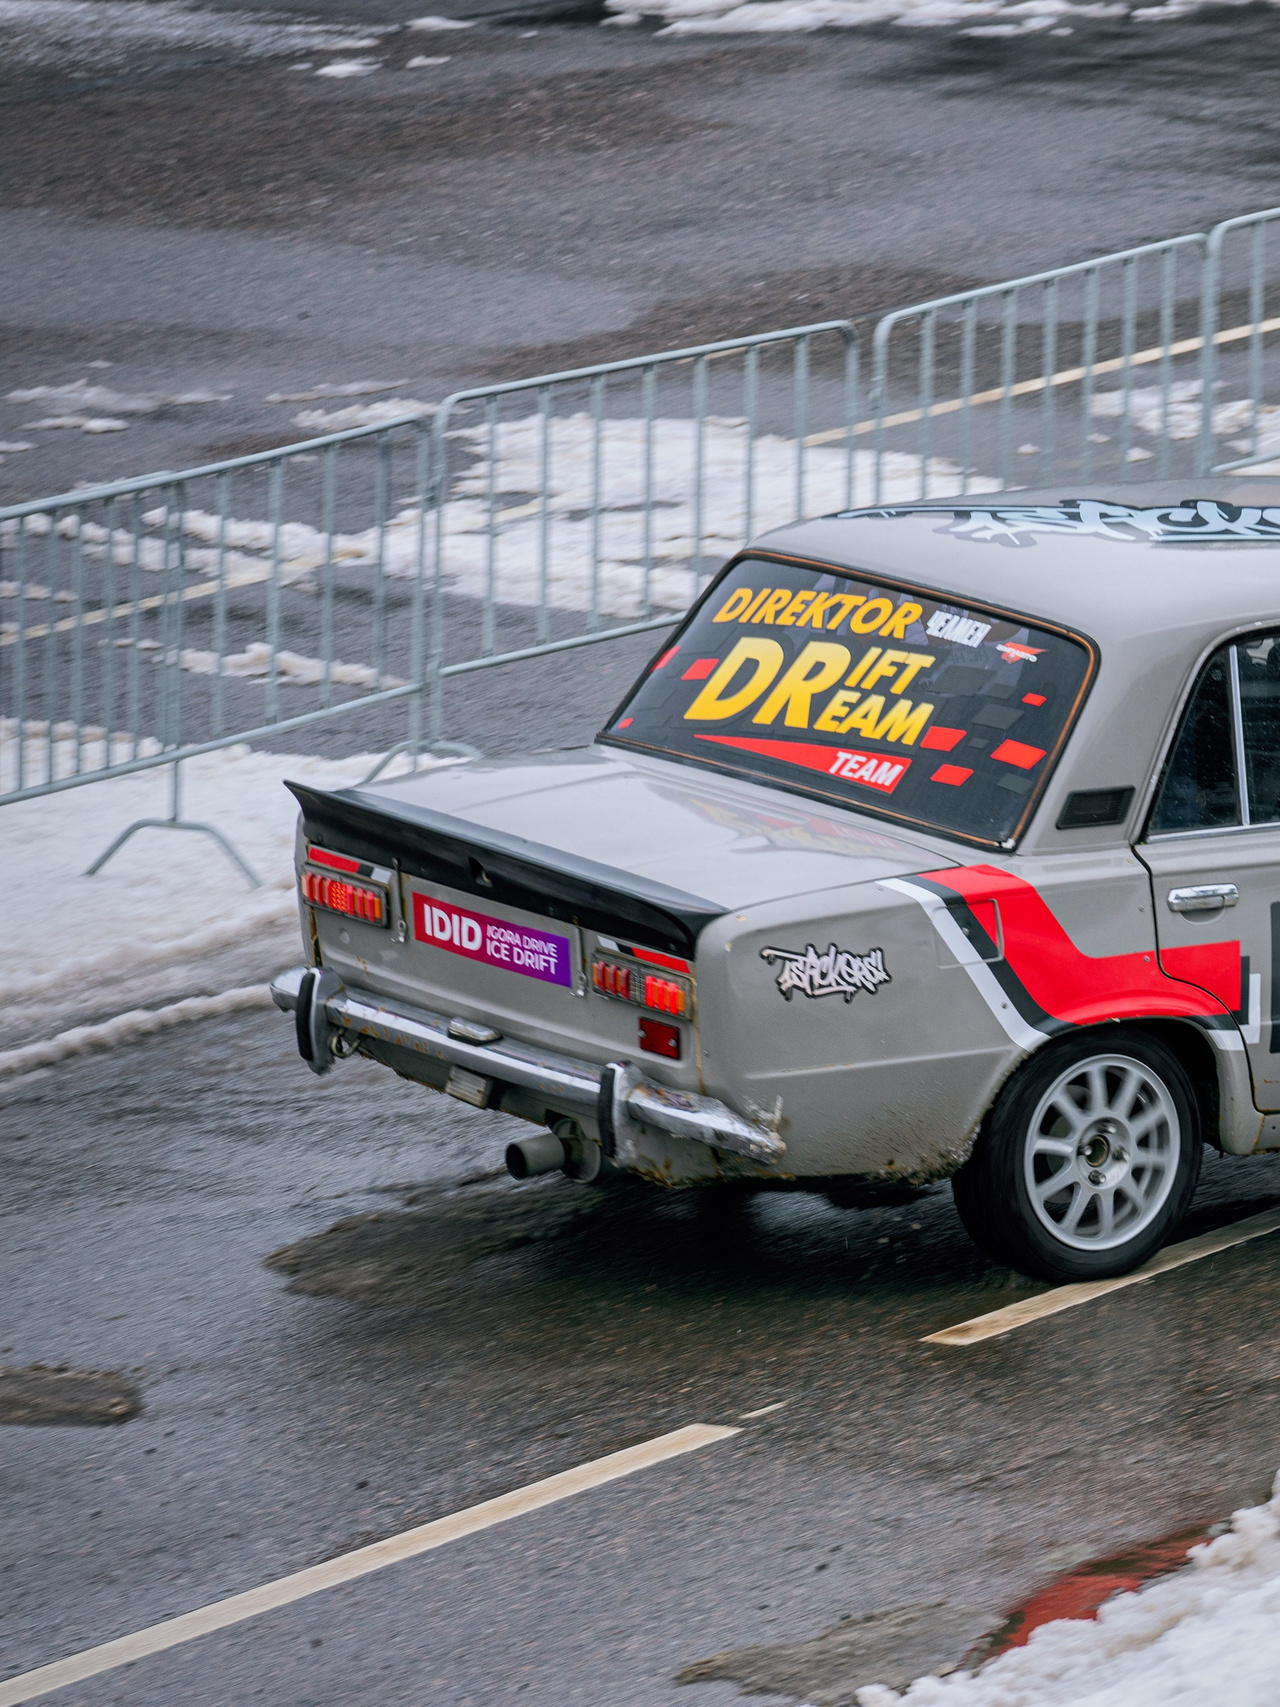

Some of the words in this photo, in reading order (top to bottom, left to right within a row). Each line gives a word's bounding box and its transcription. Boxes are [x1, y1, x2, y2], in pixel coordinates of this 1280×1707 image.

[711, 587, 923, 640] DIREKTOR
[828, 751, 904, 787] TEAM
[423, 903, 483, 951] IDID
[486, 923, 522, 948] IGORA
[522, 935, 559, 958] DRIVE
[486, 938, 511, 962] ICE
[512, 948, 559, 975] DRIFT
